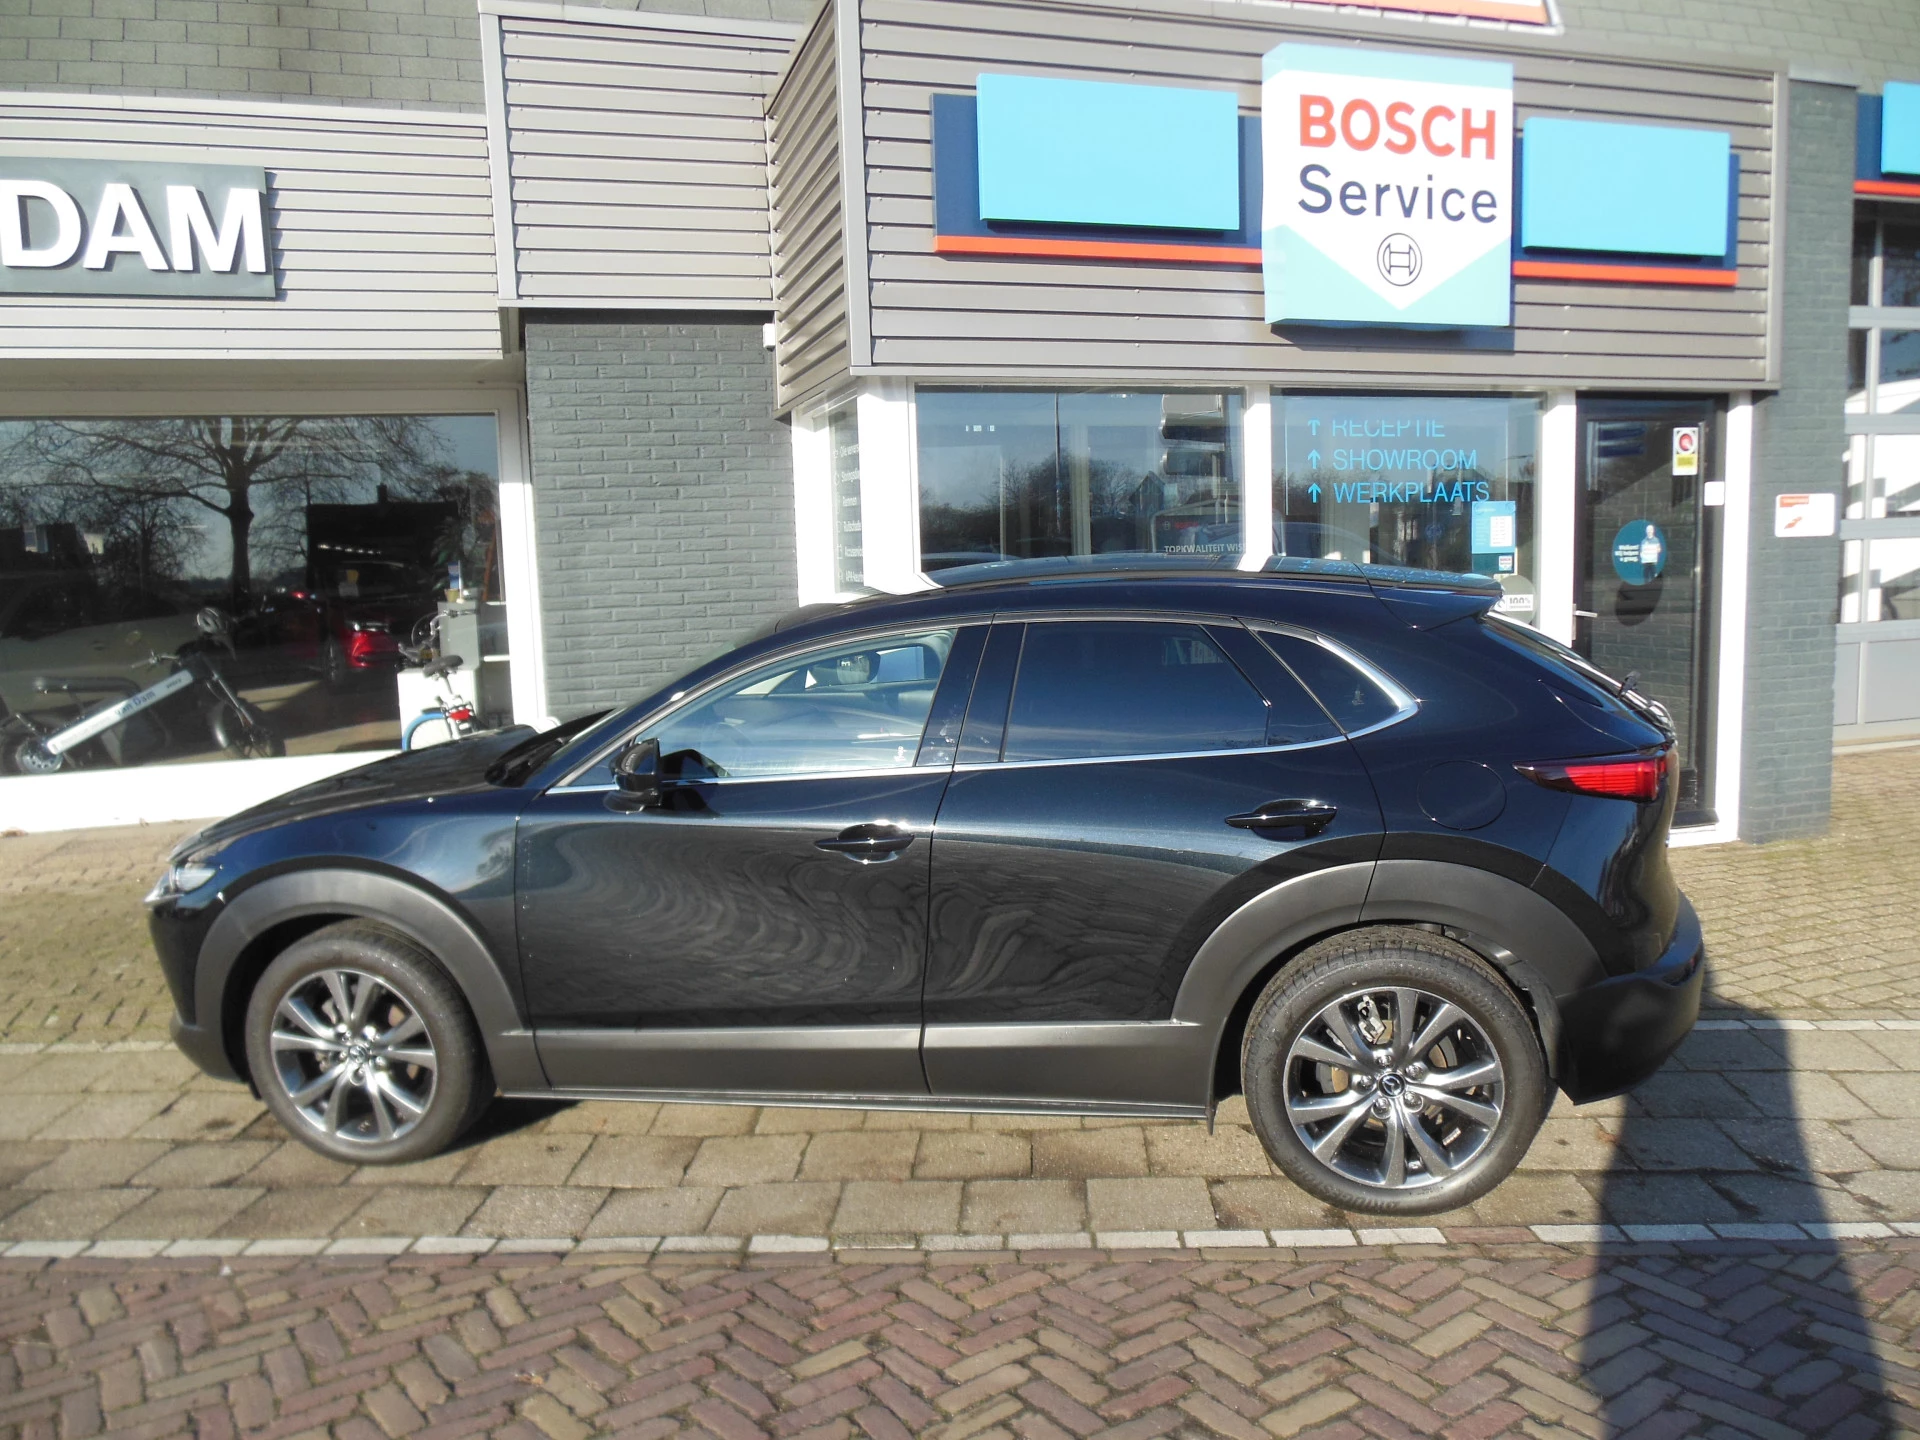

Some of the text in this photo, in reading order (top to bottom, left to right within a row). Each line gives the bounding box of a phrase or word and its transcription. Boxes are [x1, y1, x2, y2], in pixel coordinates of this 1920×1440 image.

[1299, 94, 1496, 160] BOSCH
[1298, 164, 1497, 223] Service
[0, 179, 267, 272] DAM
[1332, 419, 1446, 437] RECEPTIE
[1332, 449, 1477, 470] SHOWROOM
[1333, 482, 1490, 504] WERKPLAATS
[1164, 543, 1225, 553] TOPKWALITEIT
